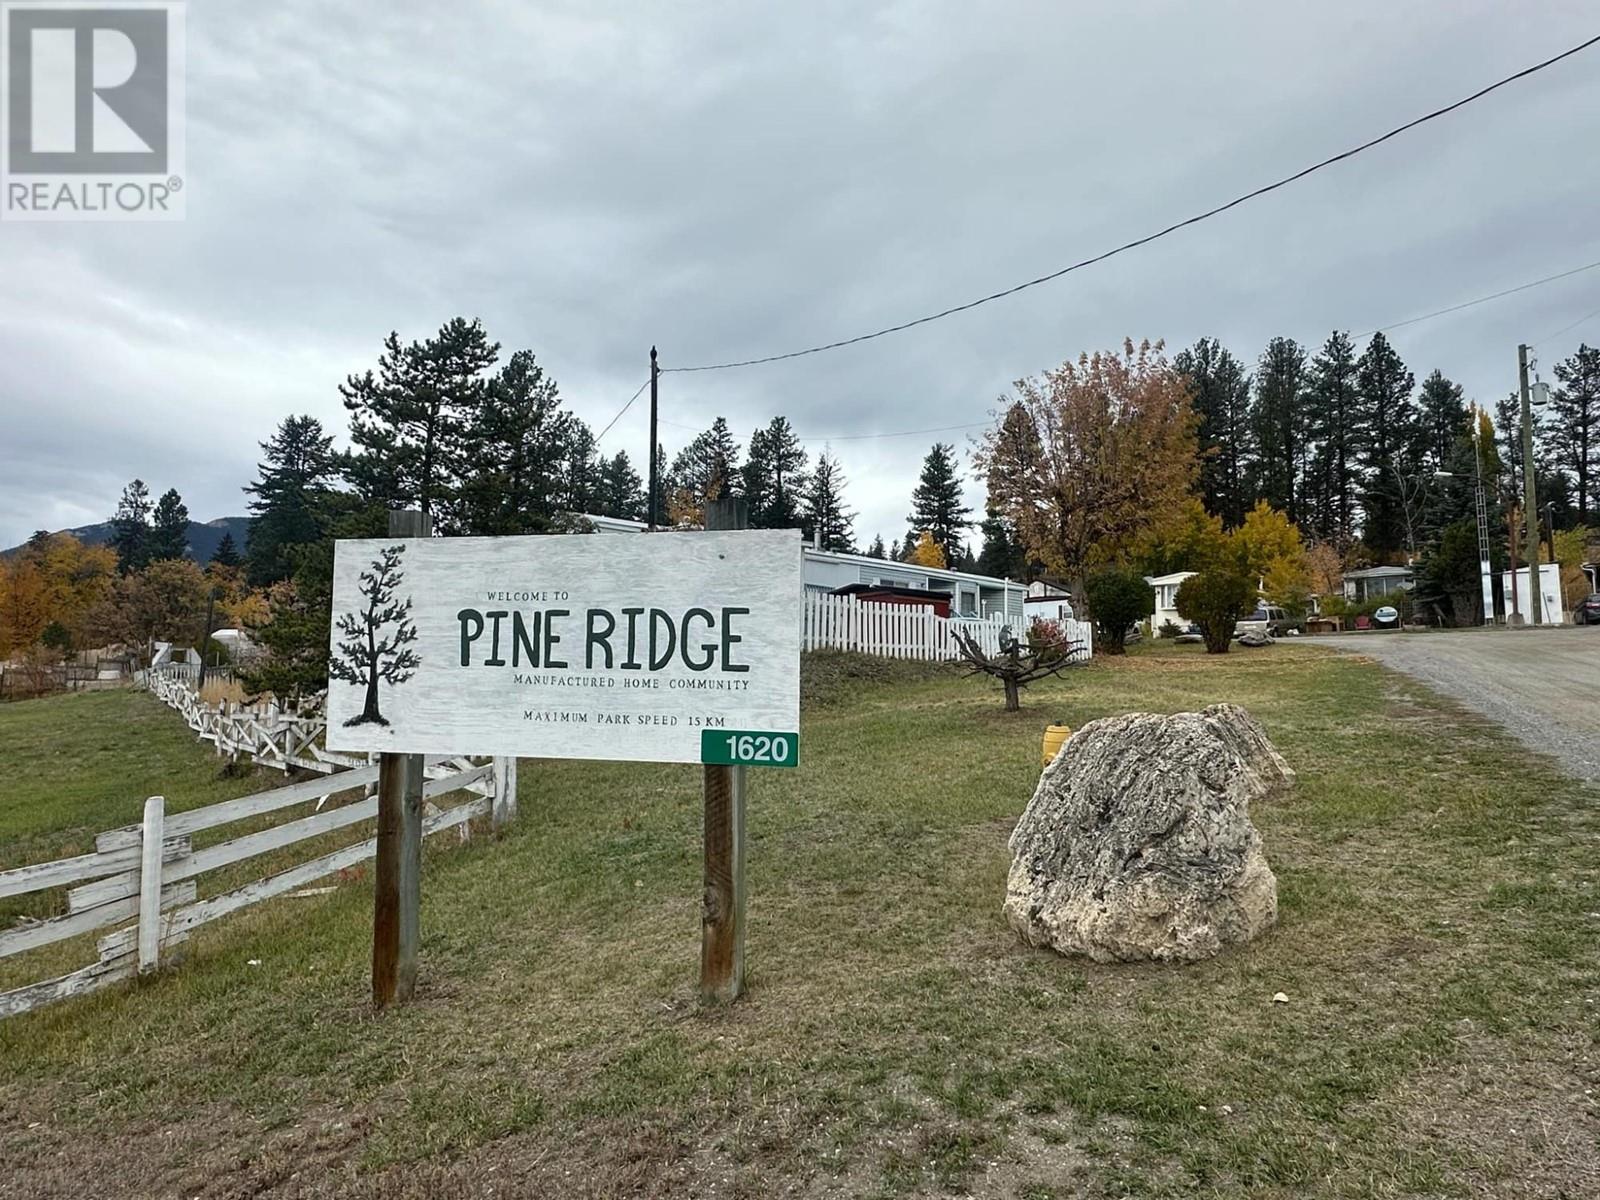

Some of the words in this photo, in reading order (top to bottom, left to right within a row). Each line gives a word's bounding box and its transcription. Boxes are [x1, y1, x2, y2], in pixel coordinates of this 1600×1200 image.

[487, 591, 549, 601] WELCOME
[554, 591, 569, 601] TO
[457, 608, 570, 668] PINE
[585, 607, 750, 672] RIDGE
[513, 674, 615, 688] MANUFACTURED
[624, 678, 660, 689] HOME
[669, 679, 749, 690] COMMUNITY
[523, 710, 588, 723] MAXIMUM
[597, 713, 630, 725] PARK
[637, 715, 678, 726] SPEED
[688, 716, 701, 727] 15
[705, 717, 725, 727] KM
[726, 735, 788, 762] 1620
